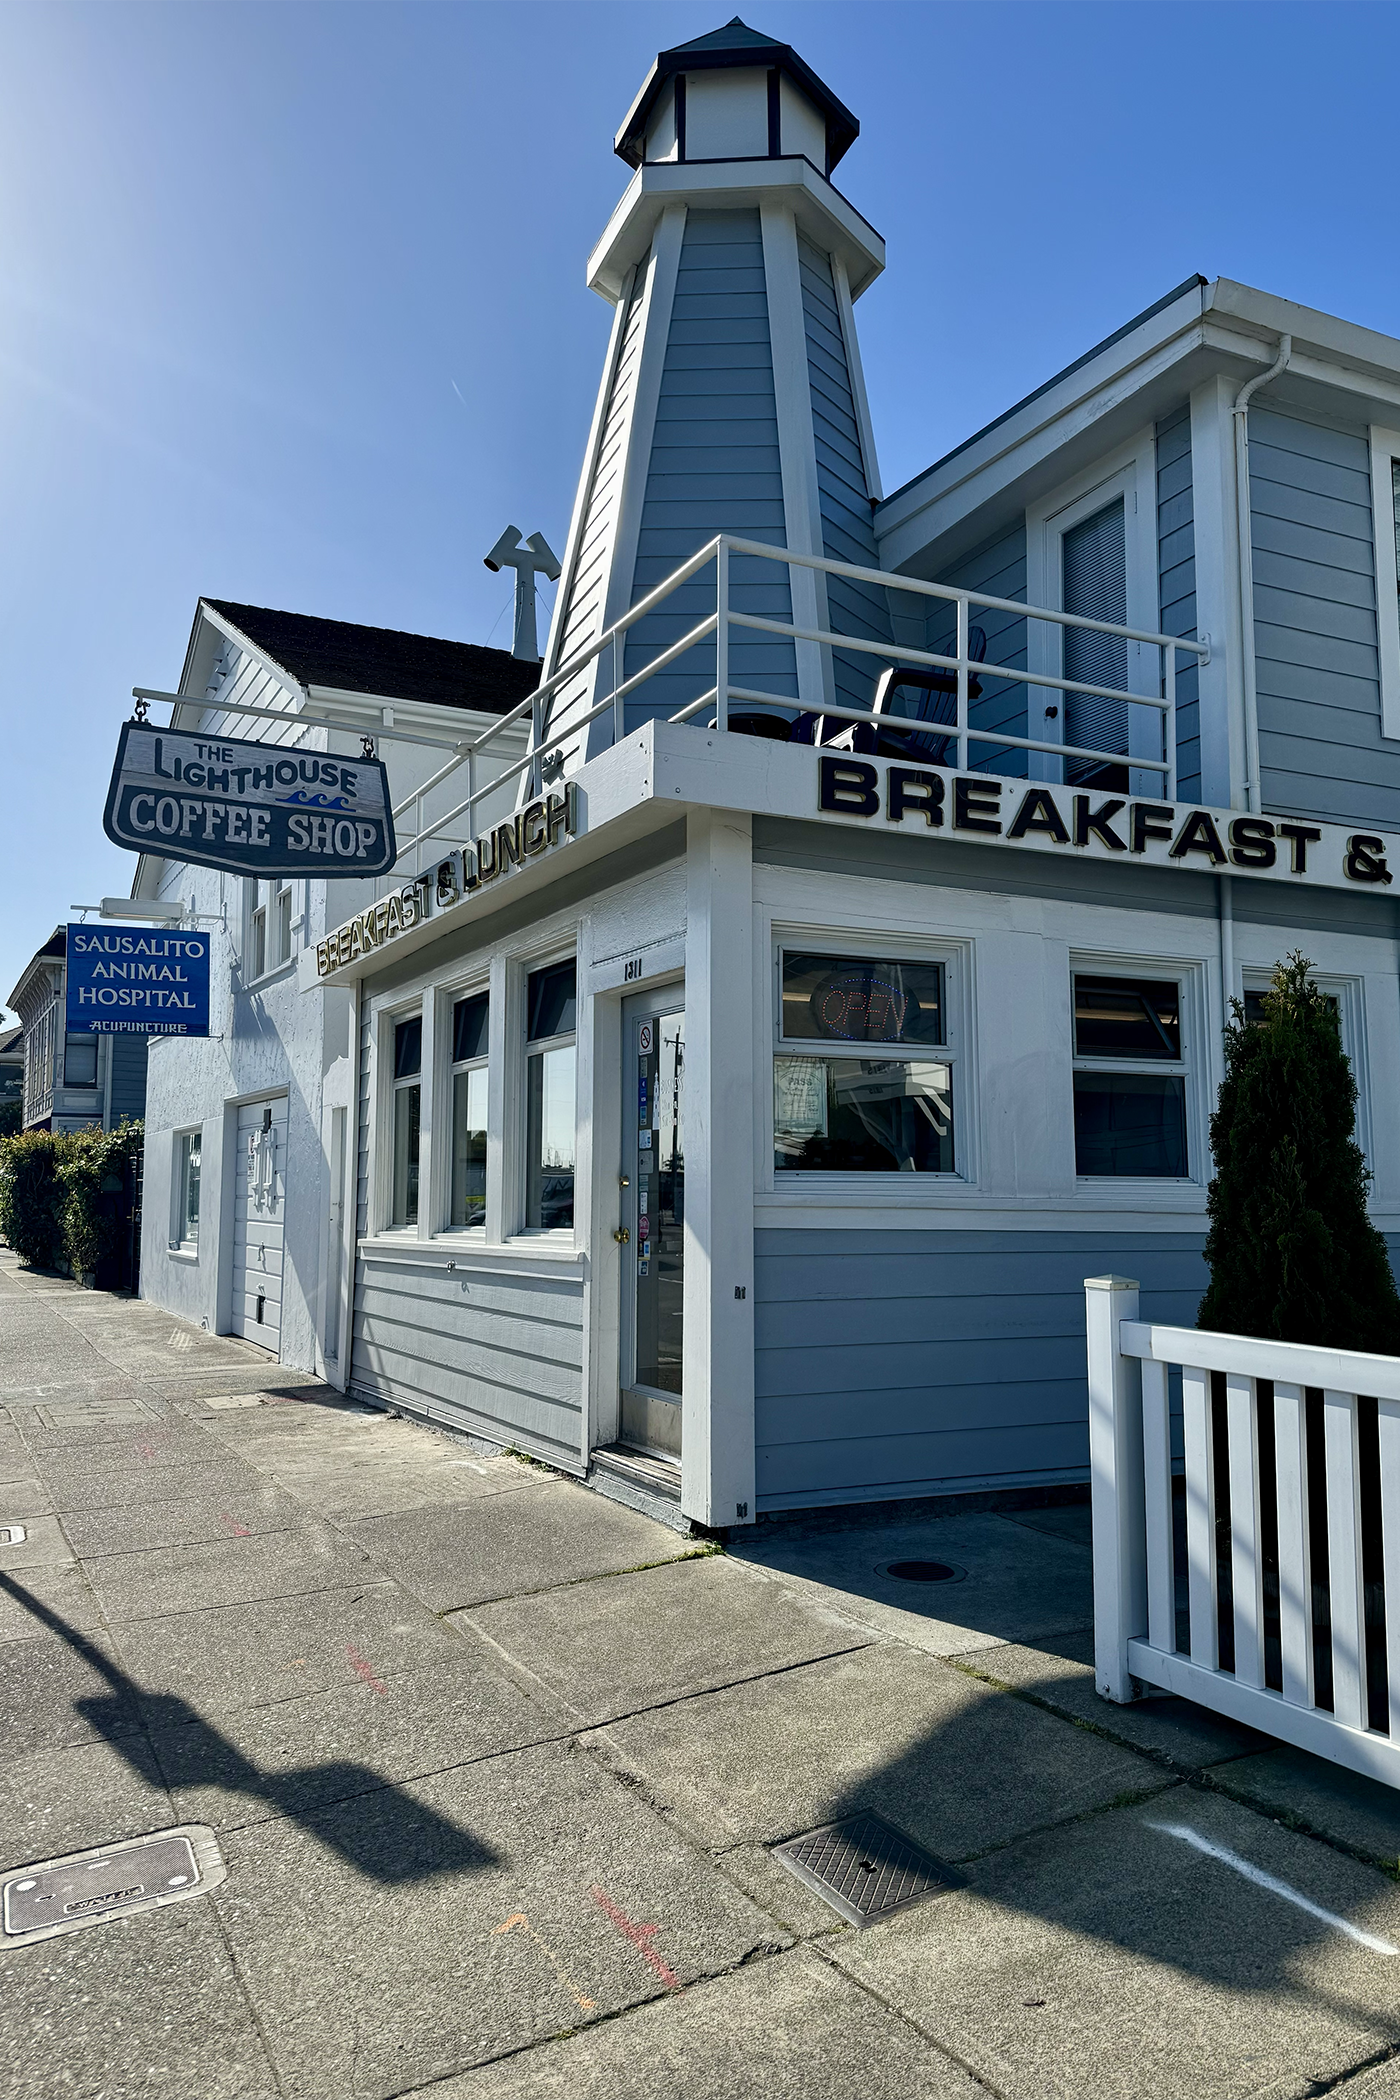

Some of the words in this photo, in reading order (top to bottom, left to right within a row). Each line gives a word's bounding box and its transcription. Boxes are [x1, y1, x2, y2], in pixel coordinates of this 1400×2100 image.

[197, 743, 234, 763] THE
[129, 793, 271, 847] COFFEE
[287, 814, 377, 858] SHOP
[817, 755, 1322, 874] BREAKFAST
[1345, 834, 1393, 884] &
[316, 873, 434, 976] BREAKFAST
[436, 860, 461, 907] &
[462, 781, 578, 893] LUNCH
[74, 935, 205, 959] SAUSALITO
[91, 961, 189, 983] ANIMAL
[624, 958, 642, 982] 1311
[78, 987, 197, 1010] HOSPITAL
[822, 990, 909, 1029] OPEN
[89, 1020, 188, 1034] ACUPUNCTURE
